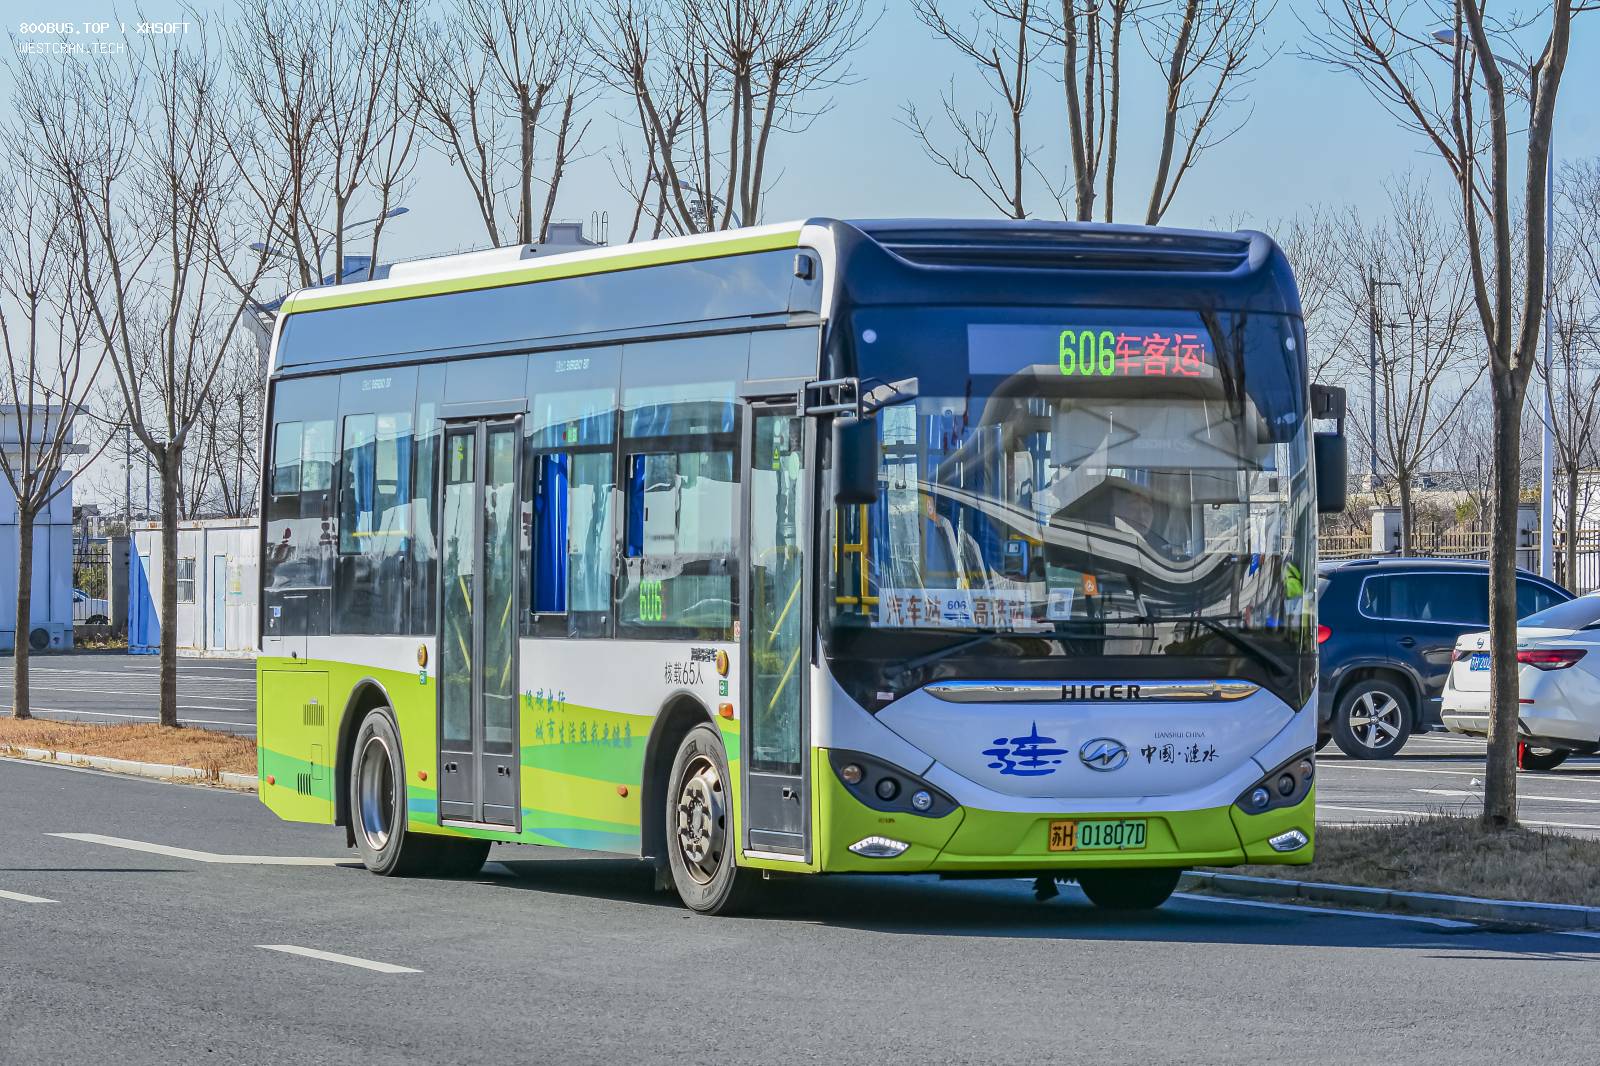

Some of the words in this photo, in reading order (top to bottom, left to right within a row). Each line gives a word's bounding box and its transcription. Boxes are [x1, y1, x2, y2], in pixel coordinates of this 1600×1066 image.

[1059, 330, 1115, 376] 606
[1116, 332, 1205, 376] 车客运
[639, 579, 663, 621] 606
[947, 600, 967, 610] 606
[664, 662, 704, 685] 核载65人
[1061, 684, 1142, 699] HIGER
[1185, 731, 1205, 739] CHINA
